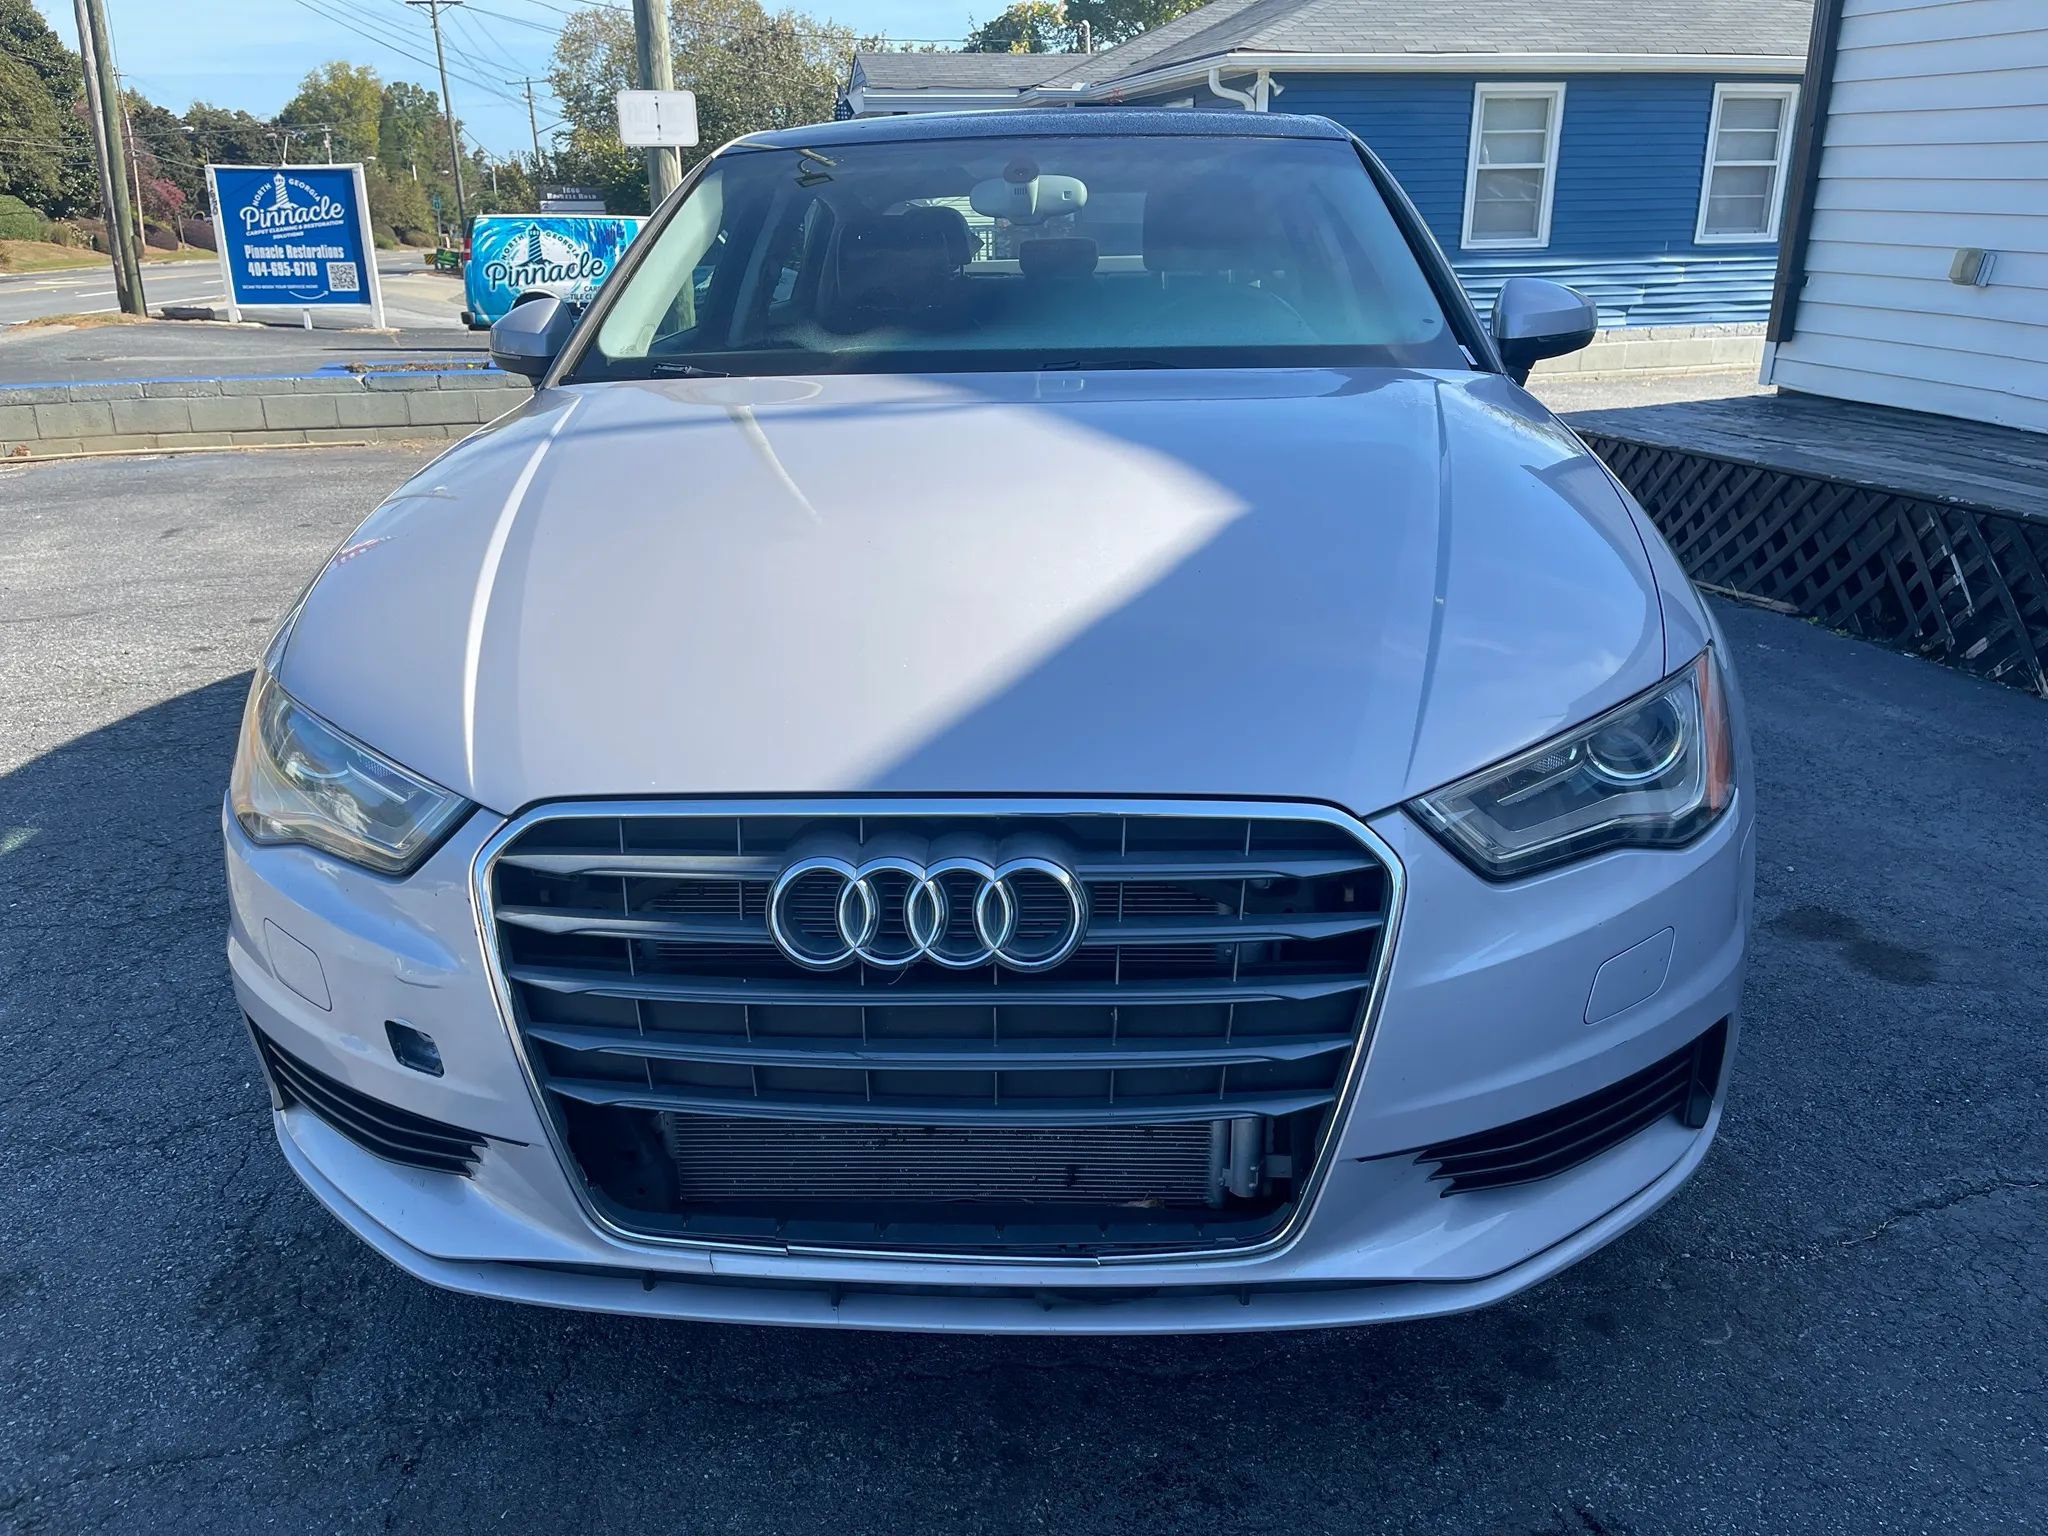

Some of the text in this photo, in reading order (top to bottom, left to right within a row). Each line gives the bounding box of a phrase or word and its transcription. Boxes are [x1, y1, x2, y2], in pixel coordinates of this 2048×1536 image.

[252, 178, 321, 206] NORTH GEORGIA
[240, 195, 345, 230] Pinnacle
[246, 227, 269, 236] CARPET
[269, 225, 298, 234] CLEANING
[303, 220, 345, 229] RESTORATION
[244, 244, 345, 259] Pinnacle Restorations
[502, 231, 580, 260] NORTH GEORGIA
[485, 251, 606, 291] Pinnacle
